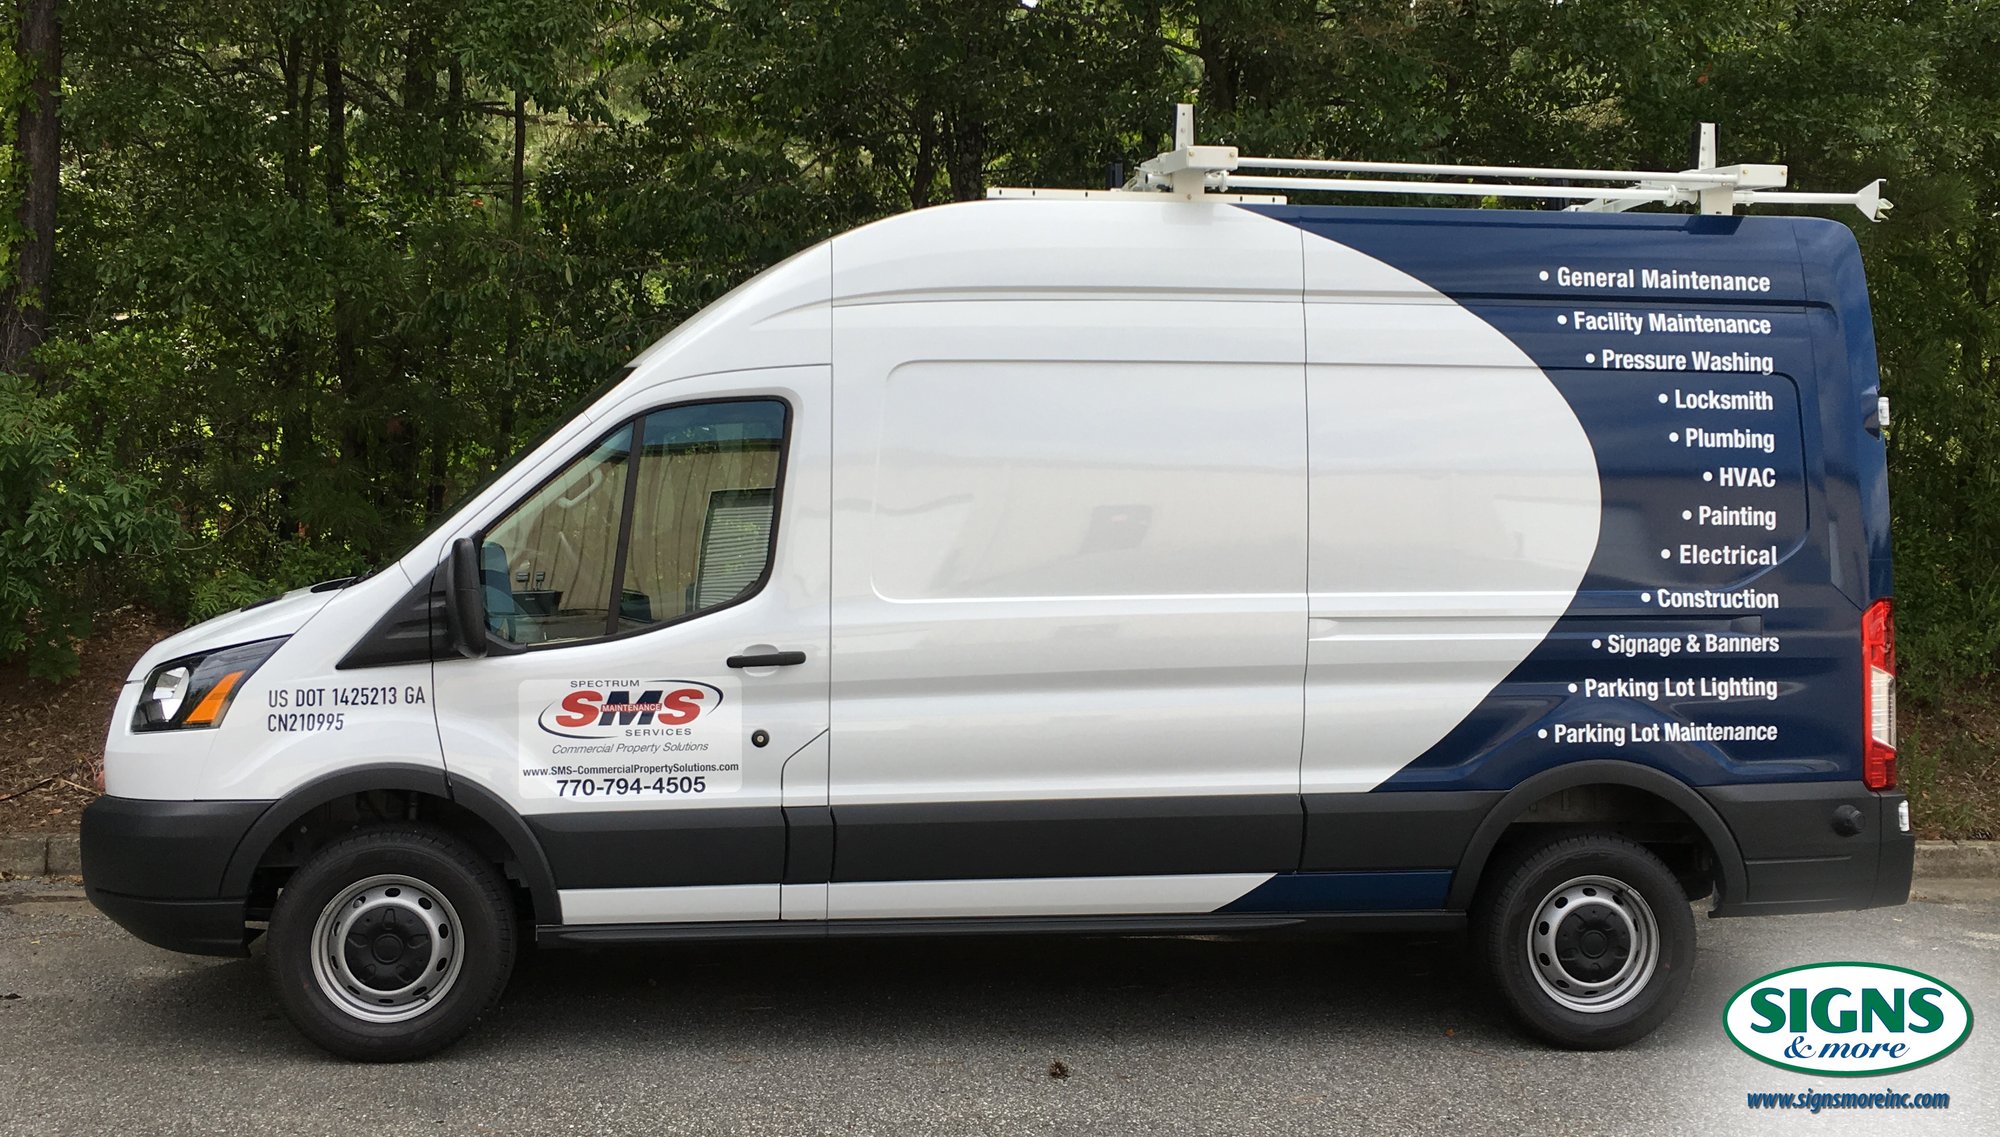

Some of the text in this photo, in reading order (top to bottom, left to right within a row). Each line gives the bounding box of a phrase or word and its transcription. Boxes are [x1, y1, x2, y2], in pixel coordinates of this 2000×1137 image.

[1558, 267, 1770, 292] General Maintenance
[1574, 311, 1771, 335] Facility Maintenance
[1602, 350, 1774, 375] Pressure Washing
[1675, 390, 1773, 411] Locksmith
[1686, 428, 1775, 453] Plumbing
[1720, 468, 1776, 488] HVAC
[1699, 506, 1776, 530] Painting
[1680, 545, 1777, 565] Electrical
[1658, 589, 1779, 609] Construction
[1608, 634, 1779, 657] Signage & Banners
[570, 680, 640, 688] SPECTRUM
[1585, 678, 1777, 701] Parking Lot Lighting
[268, 686, 426, 708] US DOT 1425213 GA
[555, 688, 704, 727] SMS
[601, 703, 662, 712] MAINTENANCE
[268, 713, 344, 732] CN210995
[625, 728, 692, 736] SERVICES
[1555, 723, 1777, 746] Parking Lot Maintenance
[552, 742, 709, 754] Commercial Property Solutions
[523, 763, 739, 776] www.SMS-CommercialPropertySolutions.com
[556, 776, 706, 796] 770-794-4505
